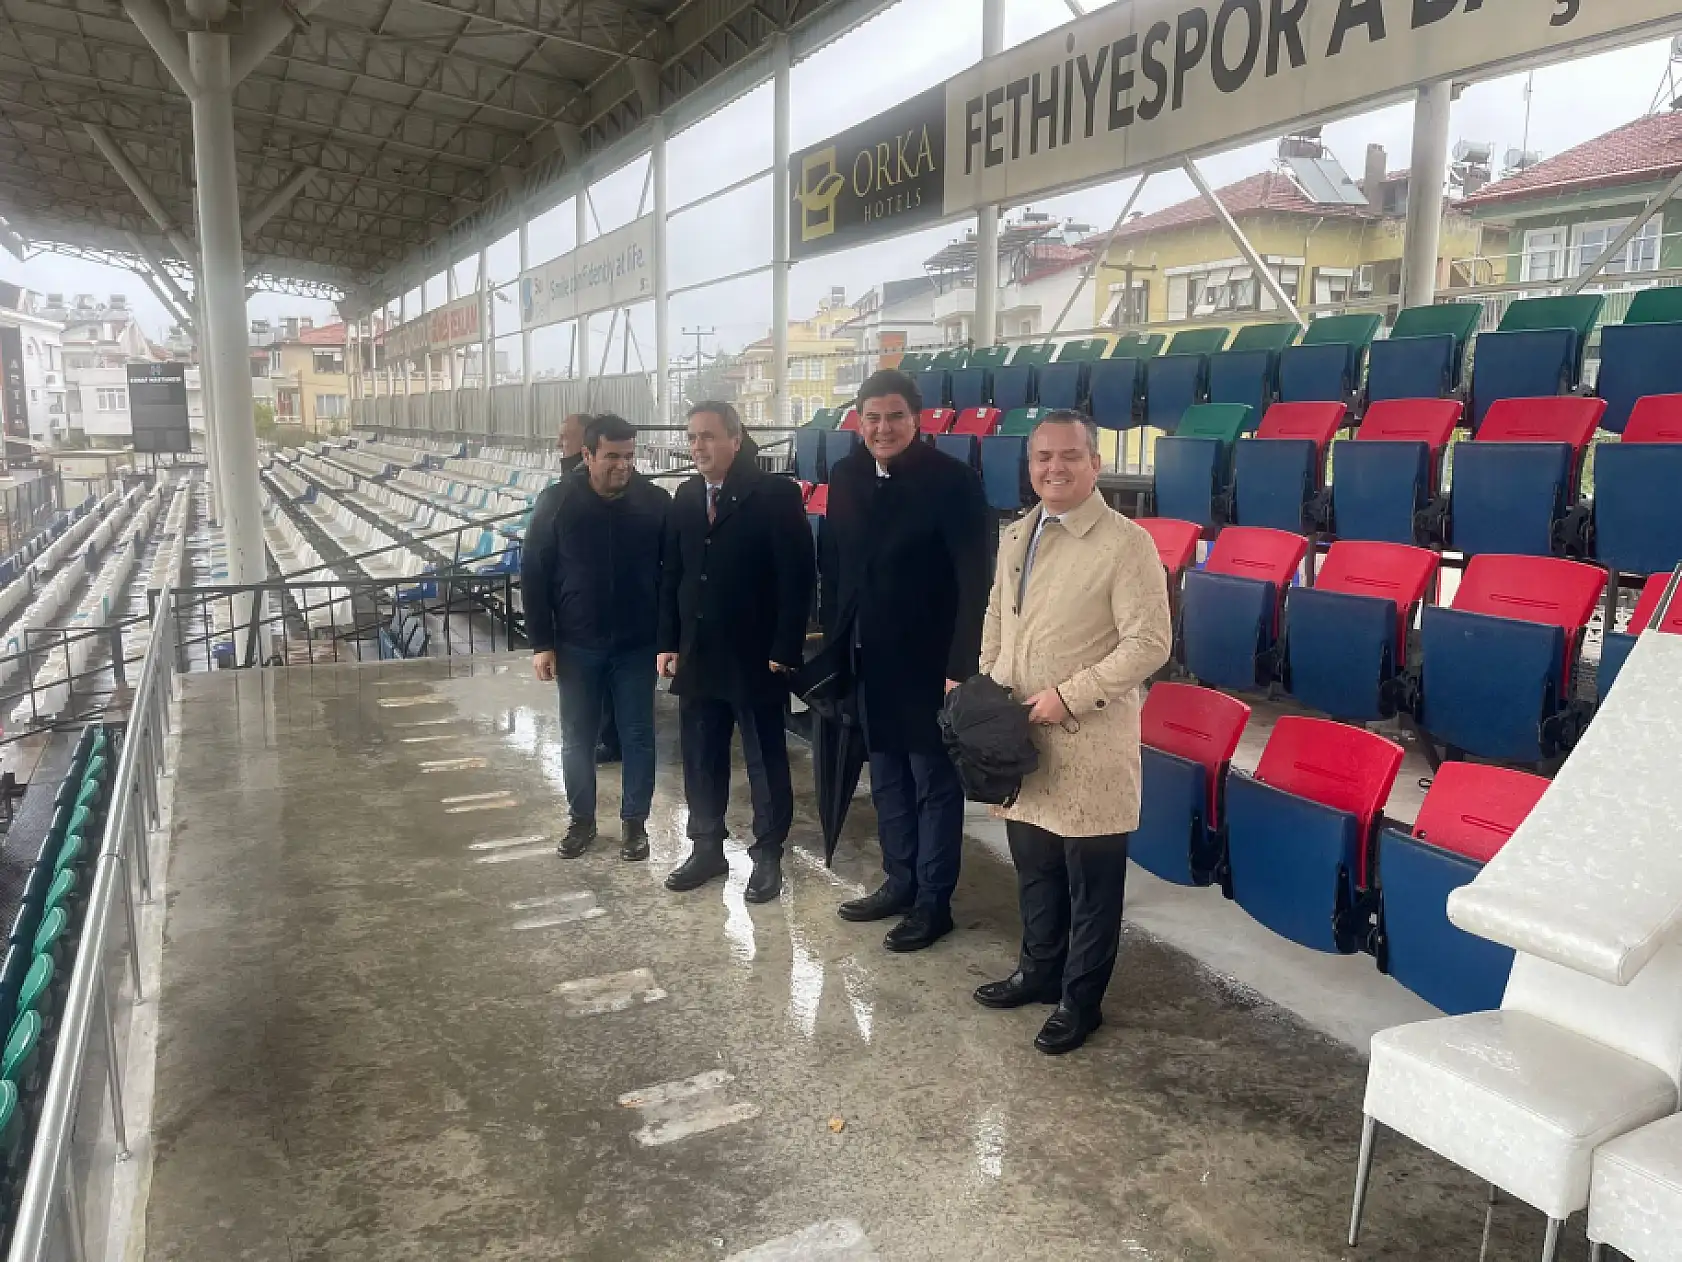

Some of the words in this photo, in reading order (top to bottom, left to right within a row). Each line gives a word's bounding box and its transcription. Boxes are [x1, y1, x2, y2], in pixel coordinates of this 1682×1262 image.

[964, 0, 1306, 176] FETHİYESPOR
[853, 123, 936, 198] ORKA
[864, 187, 922, 225] HOTELS
